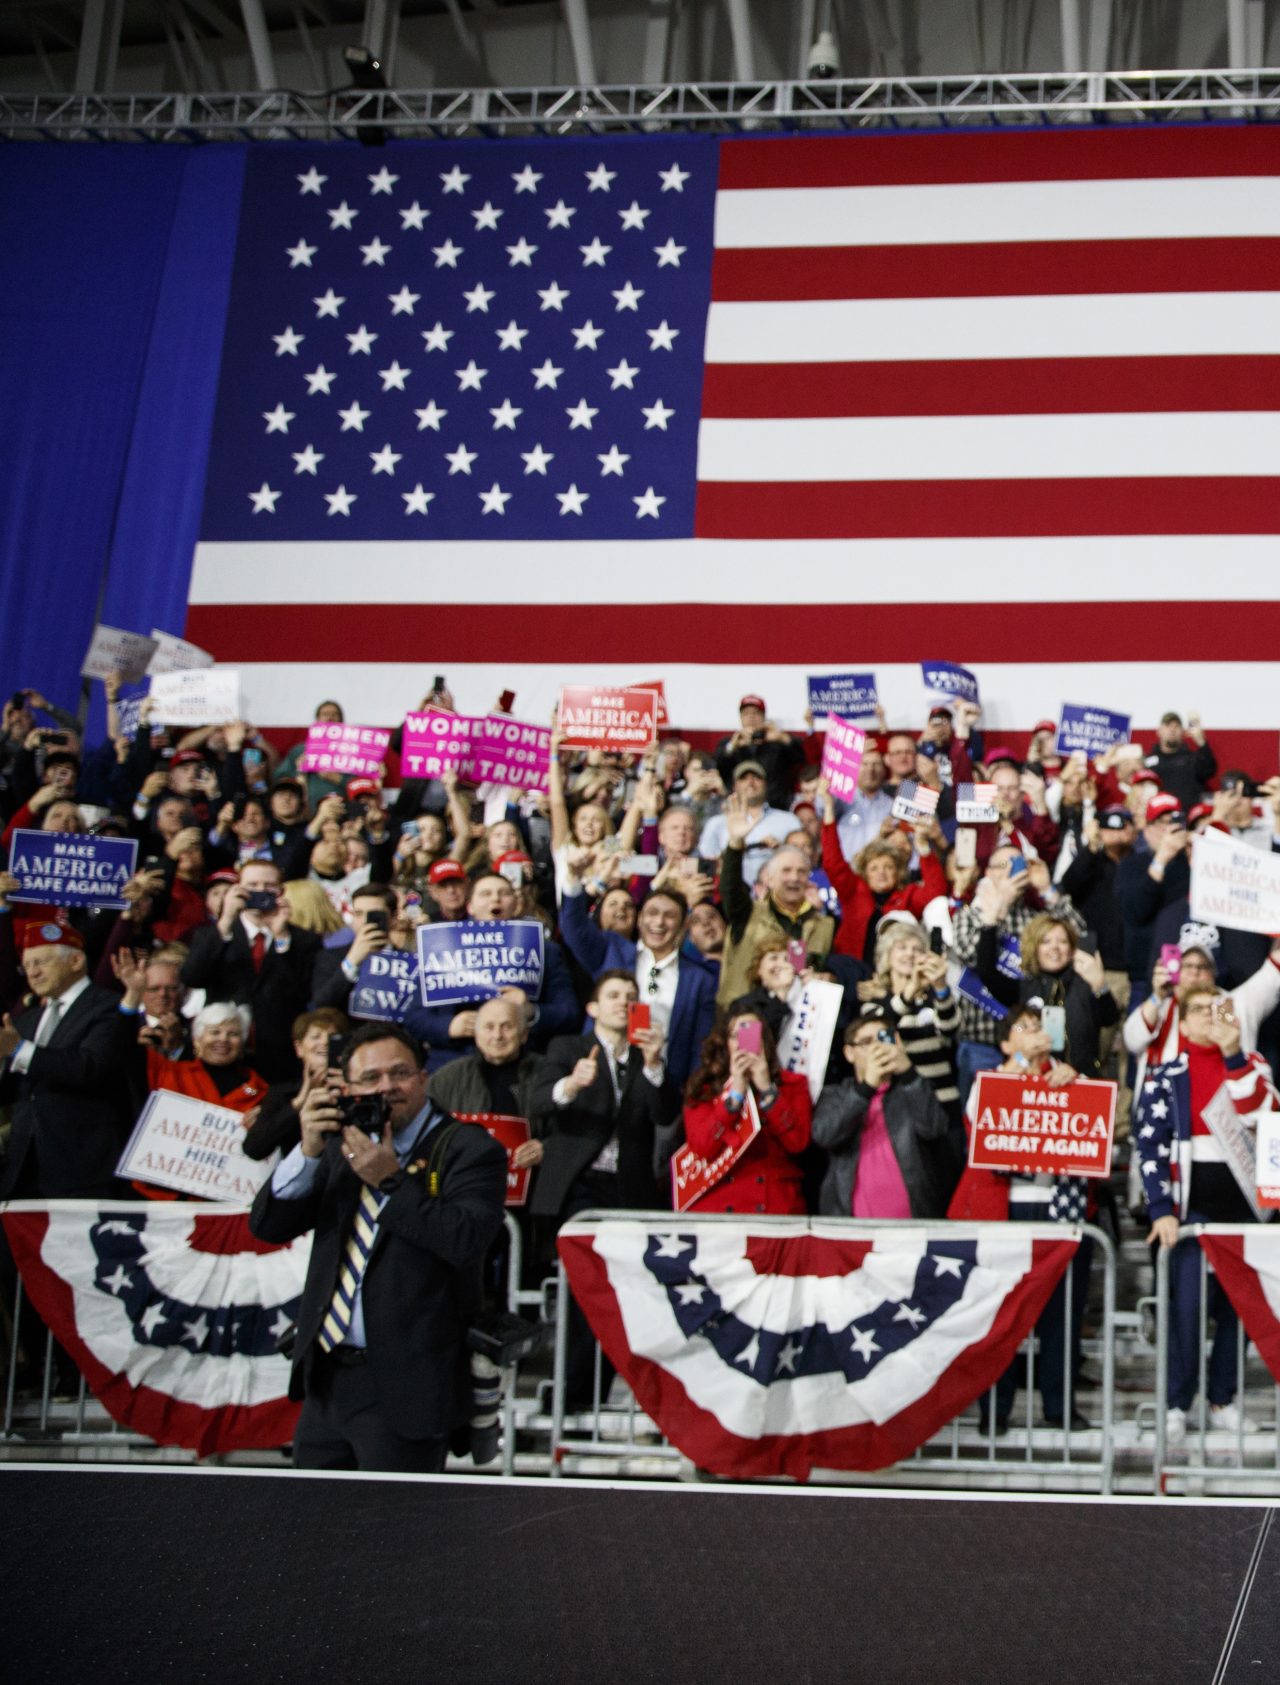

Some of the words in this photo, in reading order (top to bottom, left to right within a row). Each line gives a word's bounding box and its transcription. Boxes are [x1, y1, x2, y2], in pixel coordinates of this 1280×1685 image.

[591, 696, 625, 708] MAKE
[406, 715, 483, 737] WOME
[563, 706, 653, 729] AMERICA
[309, 725, 391, 747] WOMEN
[485, 719, 551, 749] WOME
[328, 741, 359, 755] FOR
[436, 740, 471, 754] FOR
[505, 747, 537, 765] FOR
[306, 754, 380, 774] TRUMP
[407, 755, 475, 775] TRUM
[54, 843, 96, 858] MAKE
[1231, 853, 1261, 869] BUY
[13, 854, 130, 881] AMERICA
[23, 875, 63, 892] SAFE
[65, 879, 118, 896] AGAIN
[461, 932, 504, 946] MAKE
[425, 947, 540, 973] AMERICA
[425, 969, 493, 991] STRONG
[494, 967, 540, 985] AGAIN
[1022, 1089, 1069, 1108] MAKE
[201, 1111, 242, 1135] BUY
[977, 1106, 1108, 1139] AMERICA
[151, 1117, 244, 1156] AMERIC
[983, 1133, 1041, 1154] GREAT
[1042, 1138, 1099, 1159] AGAIN
[184, 1146, 230, 1170] HIRE
[136, 1150, 262, 1196] AMERICAN
